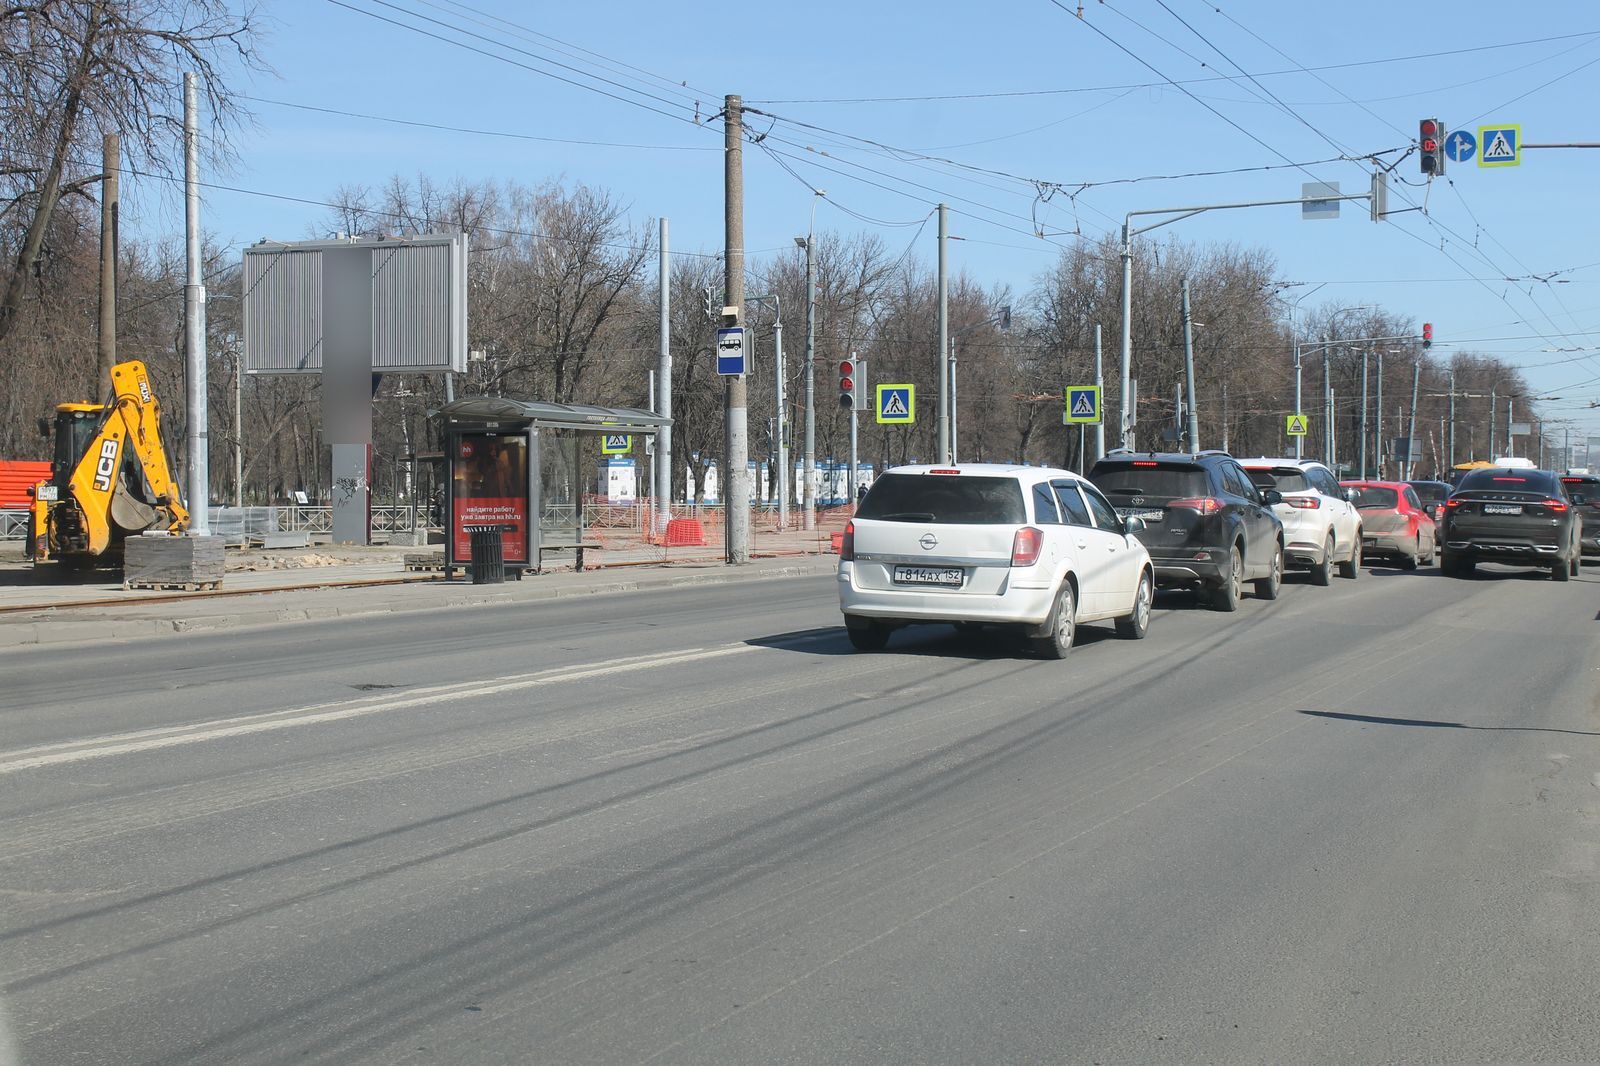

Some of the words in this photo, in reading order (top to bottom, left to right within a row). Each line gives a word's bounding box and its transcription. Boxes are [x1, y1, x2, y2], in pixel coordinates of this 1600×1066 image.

[94, 440, 117, 490] JCB
[494, 506, 515, 514] работу
[943, 570, 960, 580] 152
